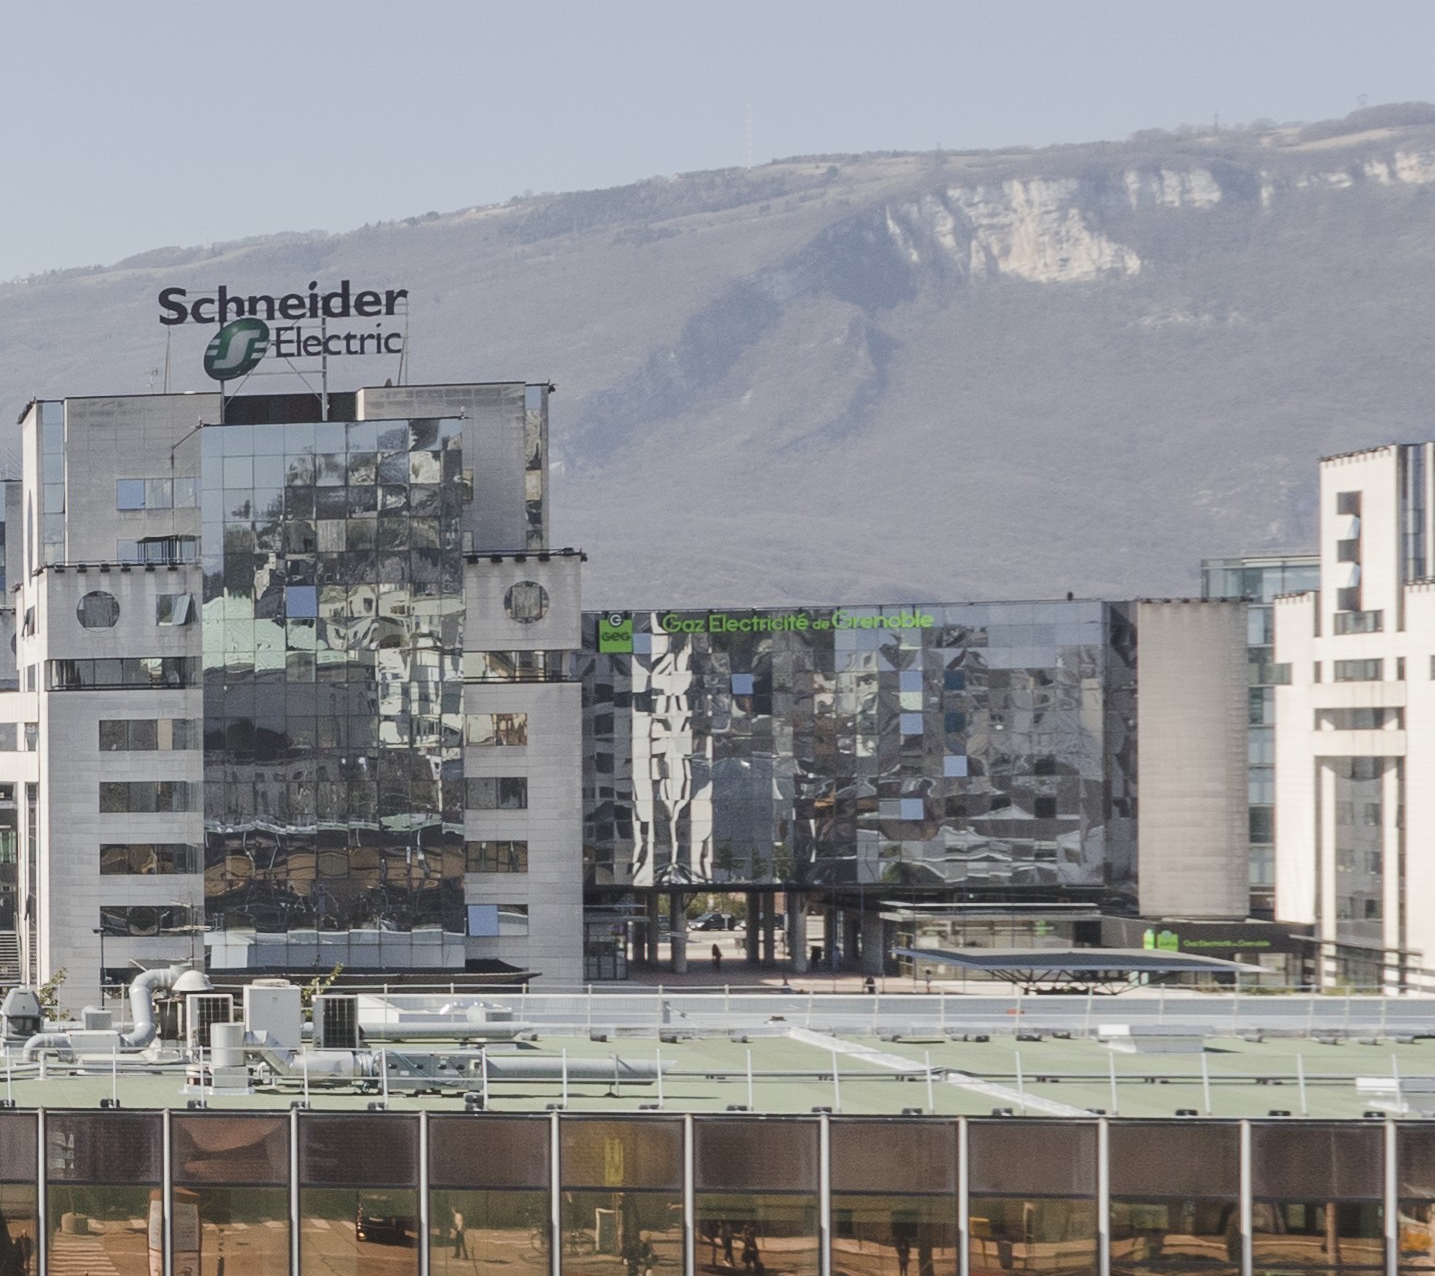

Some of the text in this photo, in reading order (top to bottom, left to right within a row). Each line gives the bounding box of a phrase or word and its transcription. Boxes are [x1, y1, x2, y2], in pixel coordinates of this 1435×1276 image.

[158, 280, 409, 325] Schneider
[275, 323, 403, 357] Electric
[663, 610, 935, 633] Gaz Electricité de Grenoble
